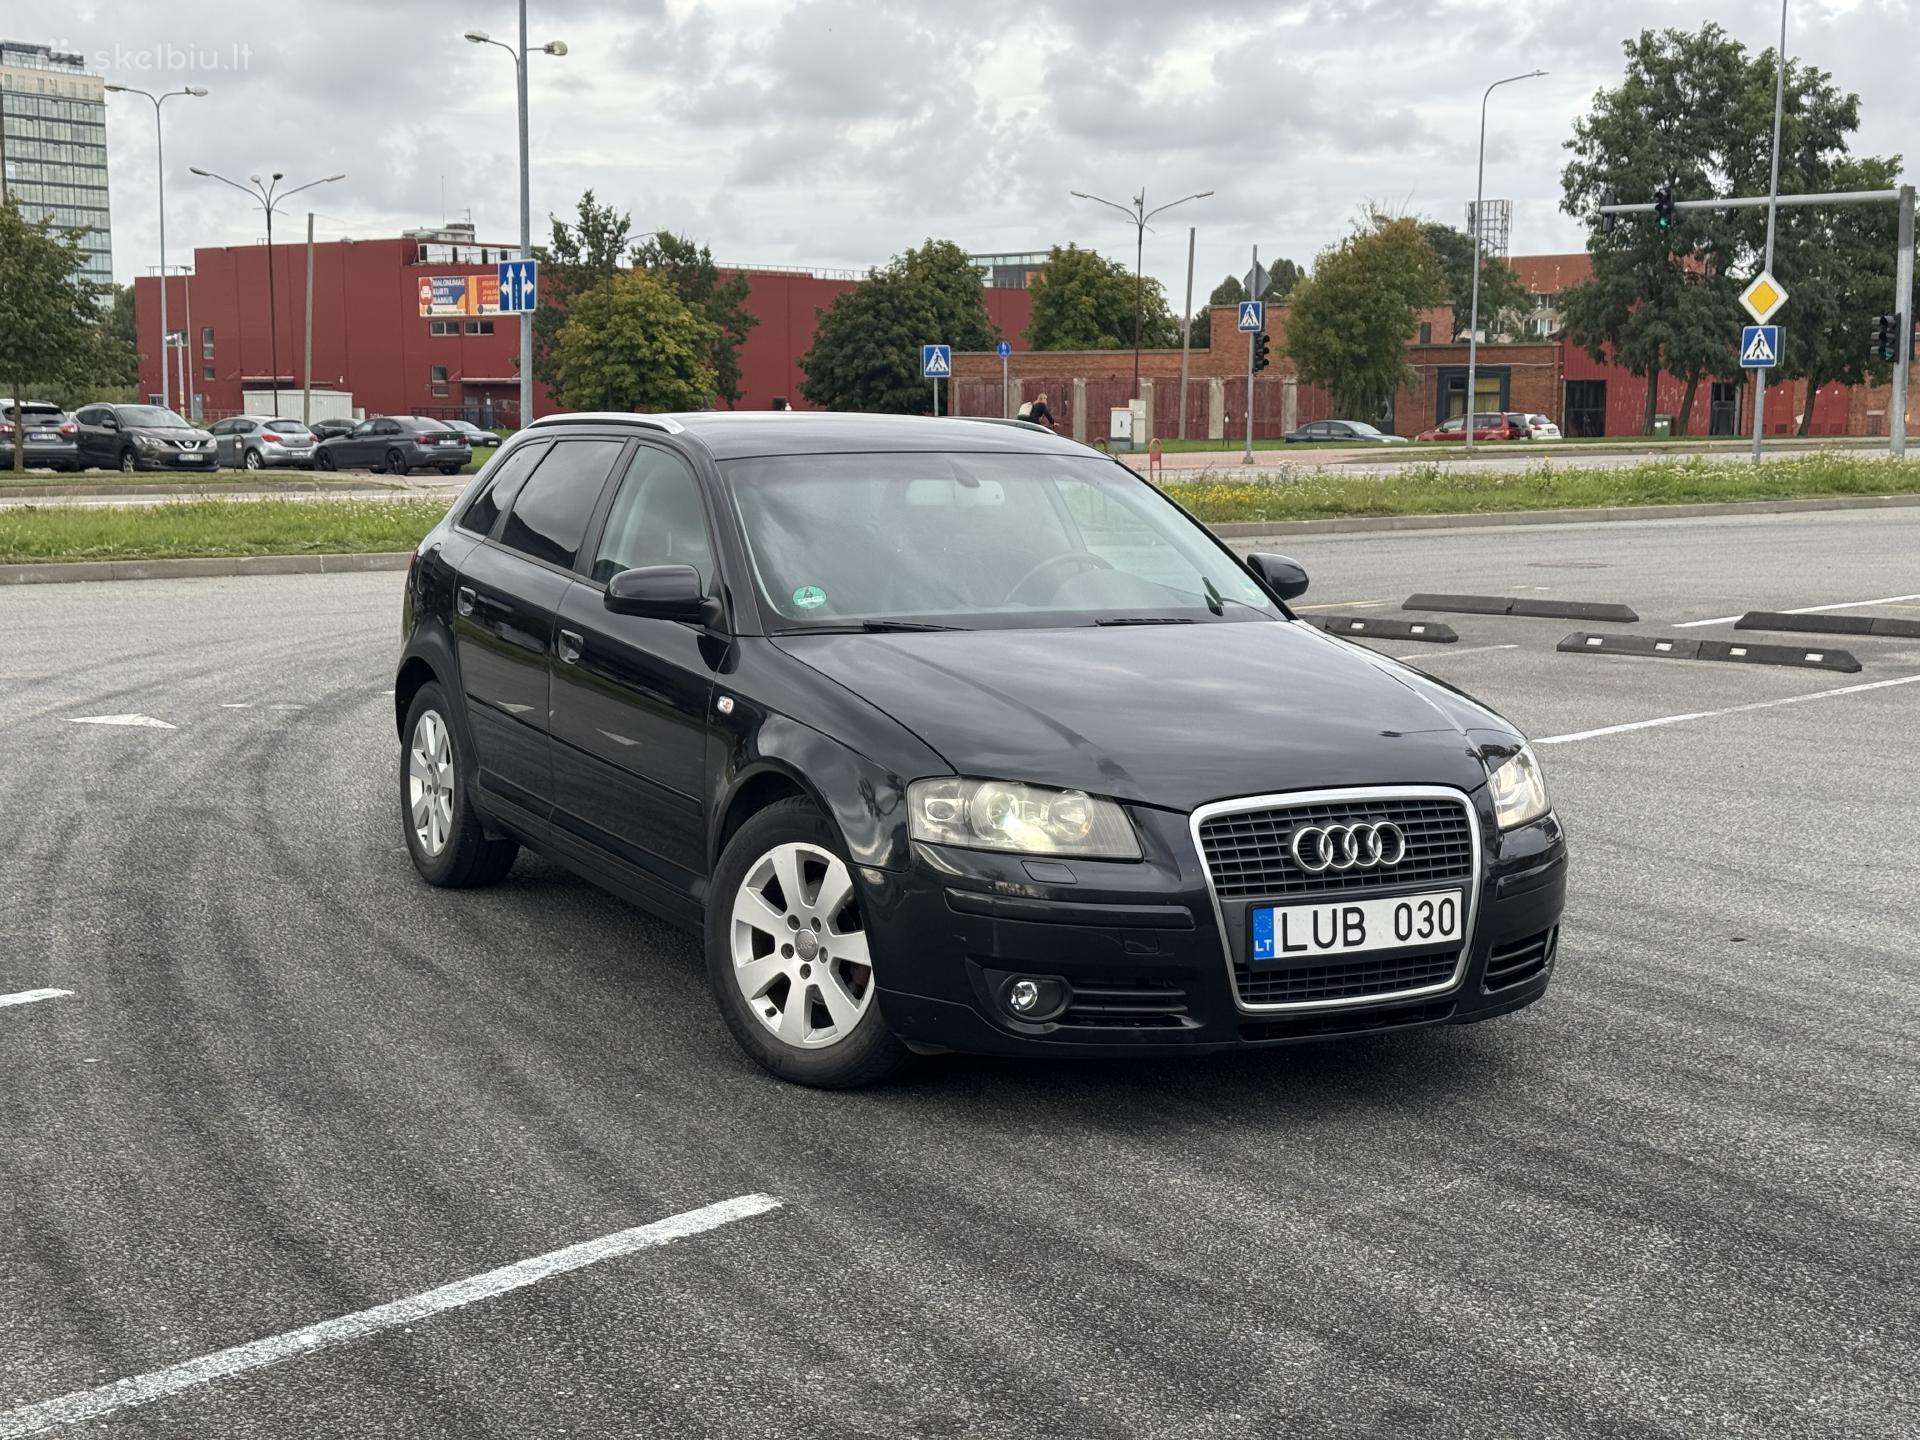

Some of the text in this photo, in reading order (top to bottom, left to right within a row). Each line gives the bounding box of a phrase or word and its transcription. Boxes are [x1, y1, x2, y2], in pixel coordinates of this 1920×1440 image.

[1281, 897, 1455, 952] LUB 030
[1254, 939, 1272, 952] LT
